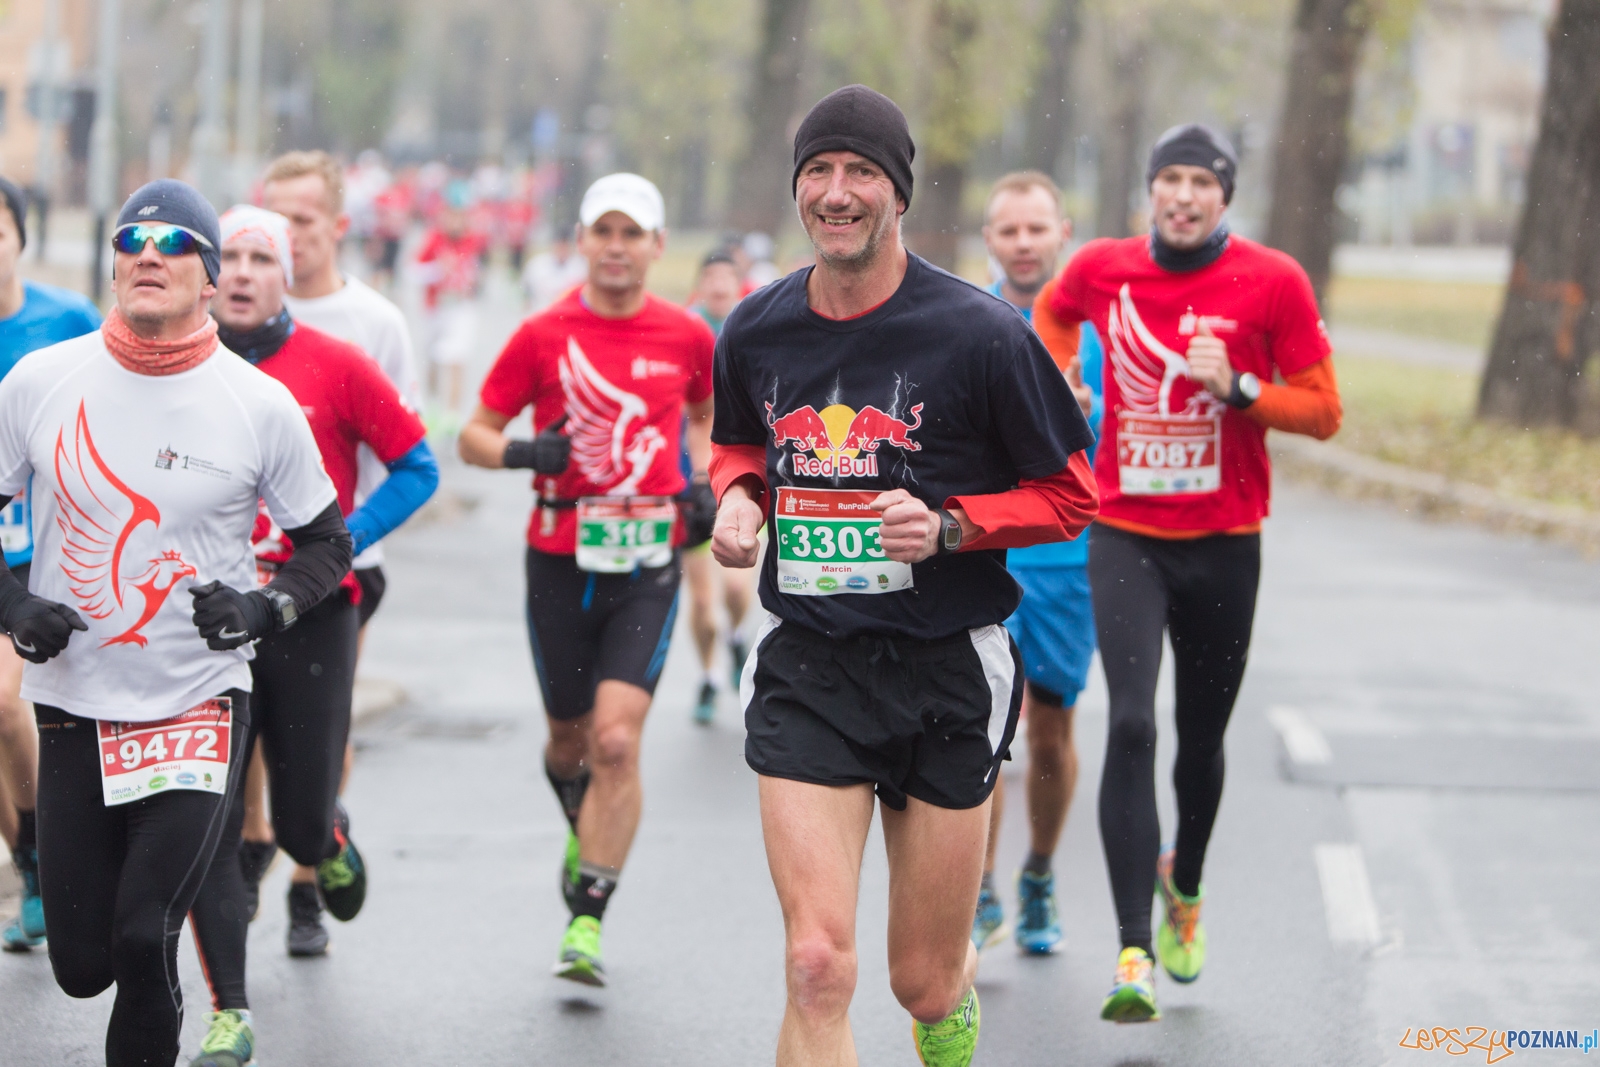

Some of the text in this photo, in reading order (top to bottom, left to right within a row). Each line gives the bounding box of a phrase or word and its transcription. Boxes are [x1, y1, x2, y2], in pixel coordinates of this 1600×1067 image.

[1127, 440, 1208, 468] 7087
[792, 453, 879, 477] Red Bull
[837, 502, 872, 511] RunPola
[780, 524, 887, 559] C 3303
[821, 565, 852, 573] Marcin
[105, 727, 218, 770] B 9472
[153, 764, 182, 773] Maciej
[110, 786, 132, 796] GRUPA
